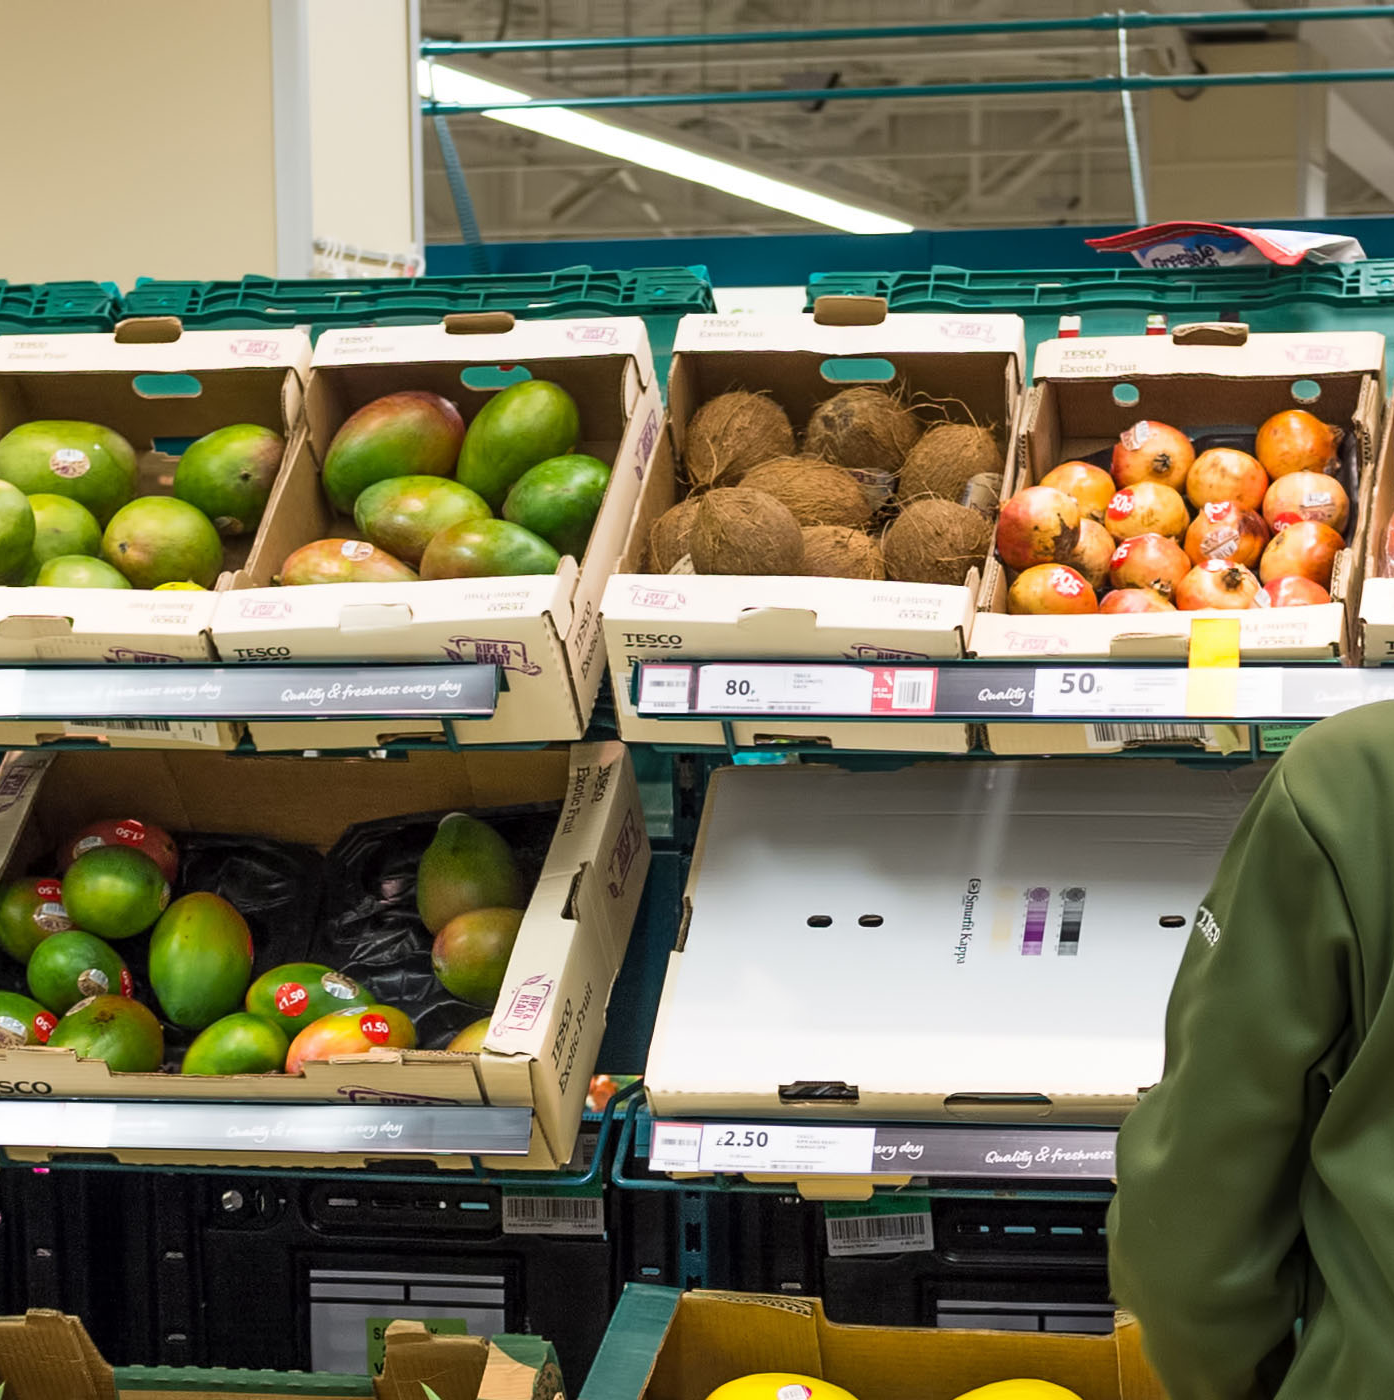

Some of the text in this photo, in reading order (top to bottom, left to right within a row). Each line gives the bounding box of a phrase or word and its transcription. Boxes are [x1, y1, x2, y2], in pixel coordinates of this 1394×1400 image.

[1062, 349, 1107, 358] TESCO
[1059, 363, 1137, 373] Exotic Fruit
[476, 643, 500, 653] RIPE
[622, 633, 683, 646] TESCO
[236, 646, 291, 658] TESCO
[280, 680, 463, 706] Quality & freshness every day
[977, 686, 1027, 707] Quality
[561, 766, 591, 836] Exotic Fruit
[953, 894, 979, 965] Smurfit Kappa
[278, 988, 305, 1011] £1.50
[511, 993, 530, 1019] READY
[362, 1021, 389, 1034] £1.50
[550, 997, 571, 1062] TESCO
[558, 982, 593, 1096] Exotic Fruit
[715, 1130, 769, 1148] £2.50
[985, 1146, 1114, 1169] Quality & freshness
